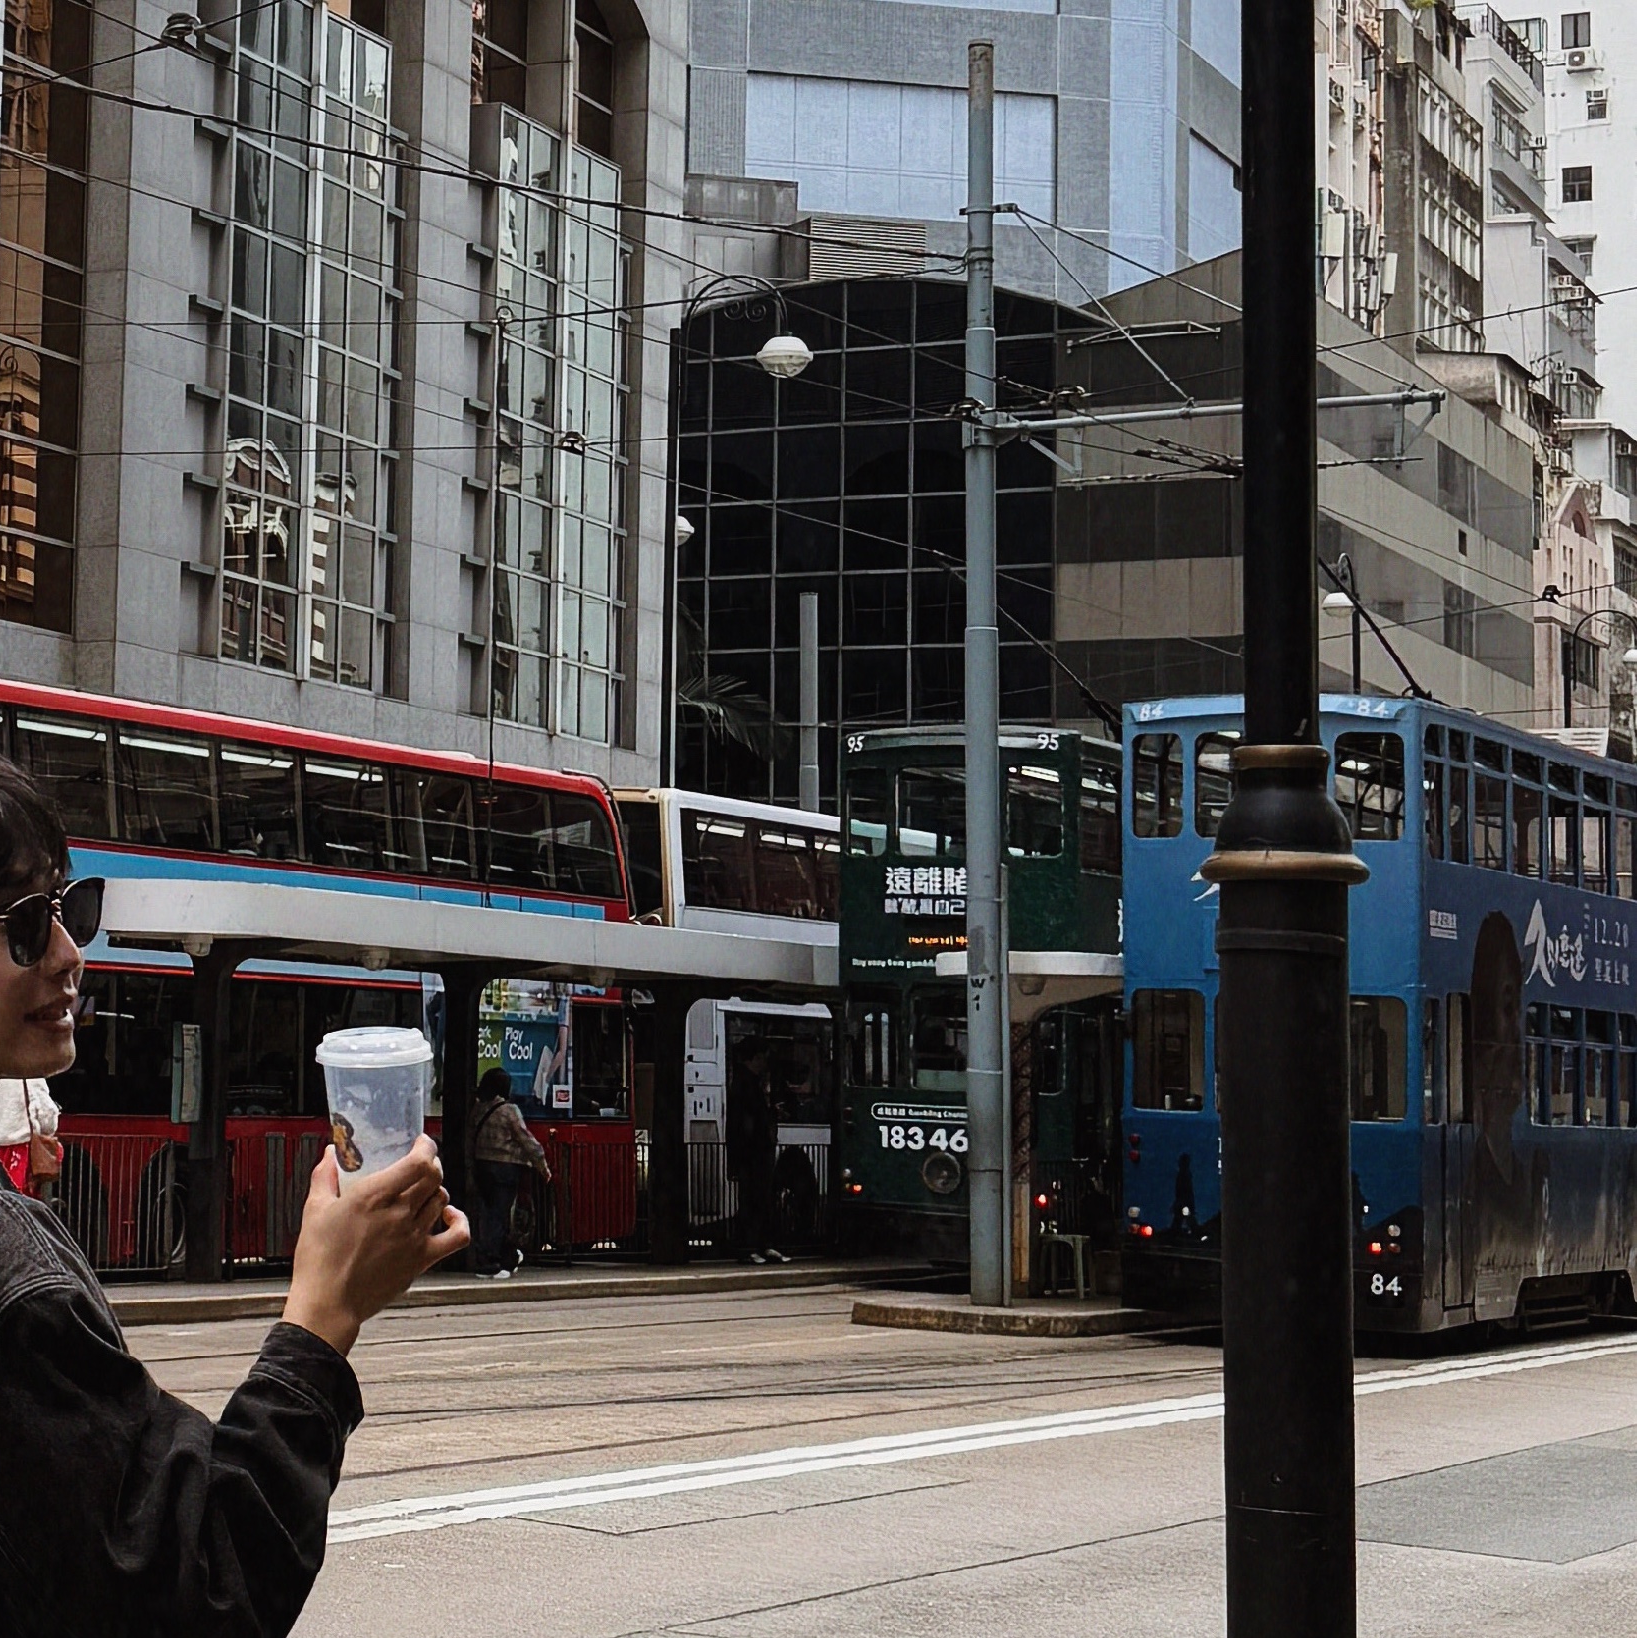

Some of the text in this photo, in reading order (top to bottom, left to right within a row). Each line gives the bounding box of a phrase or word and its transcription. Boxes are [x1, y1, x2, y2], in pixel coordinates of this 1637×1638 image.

[1139, 703, 1163, 722] 84
[1357, 699, 1388, 716] 84
[847, 736, 864, 753] 95
[1037, 734, 1059, 750] 95
[505, 1026, 524, 1044] Play
[509, 1041, 533, 1060] Cool
[1371, 1273, 1403, 1296] 84
